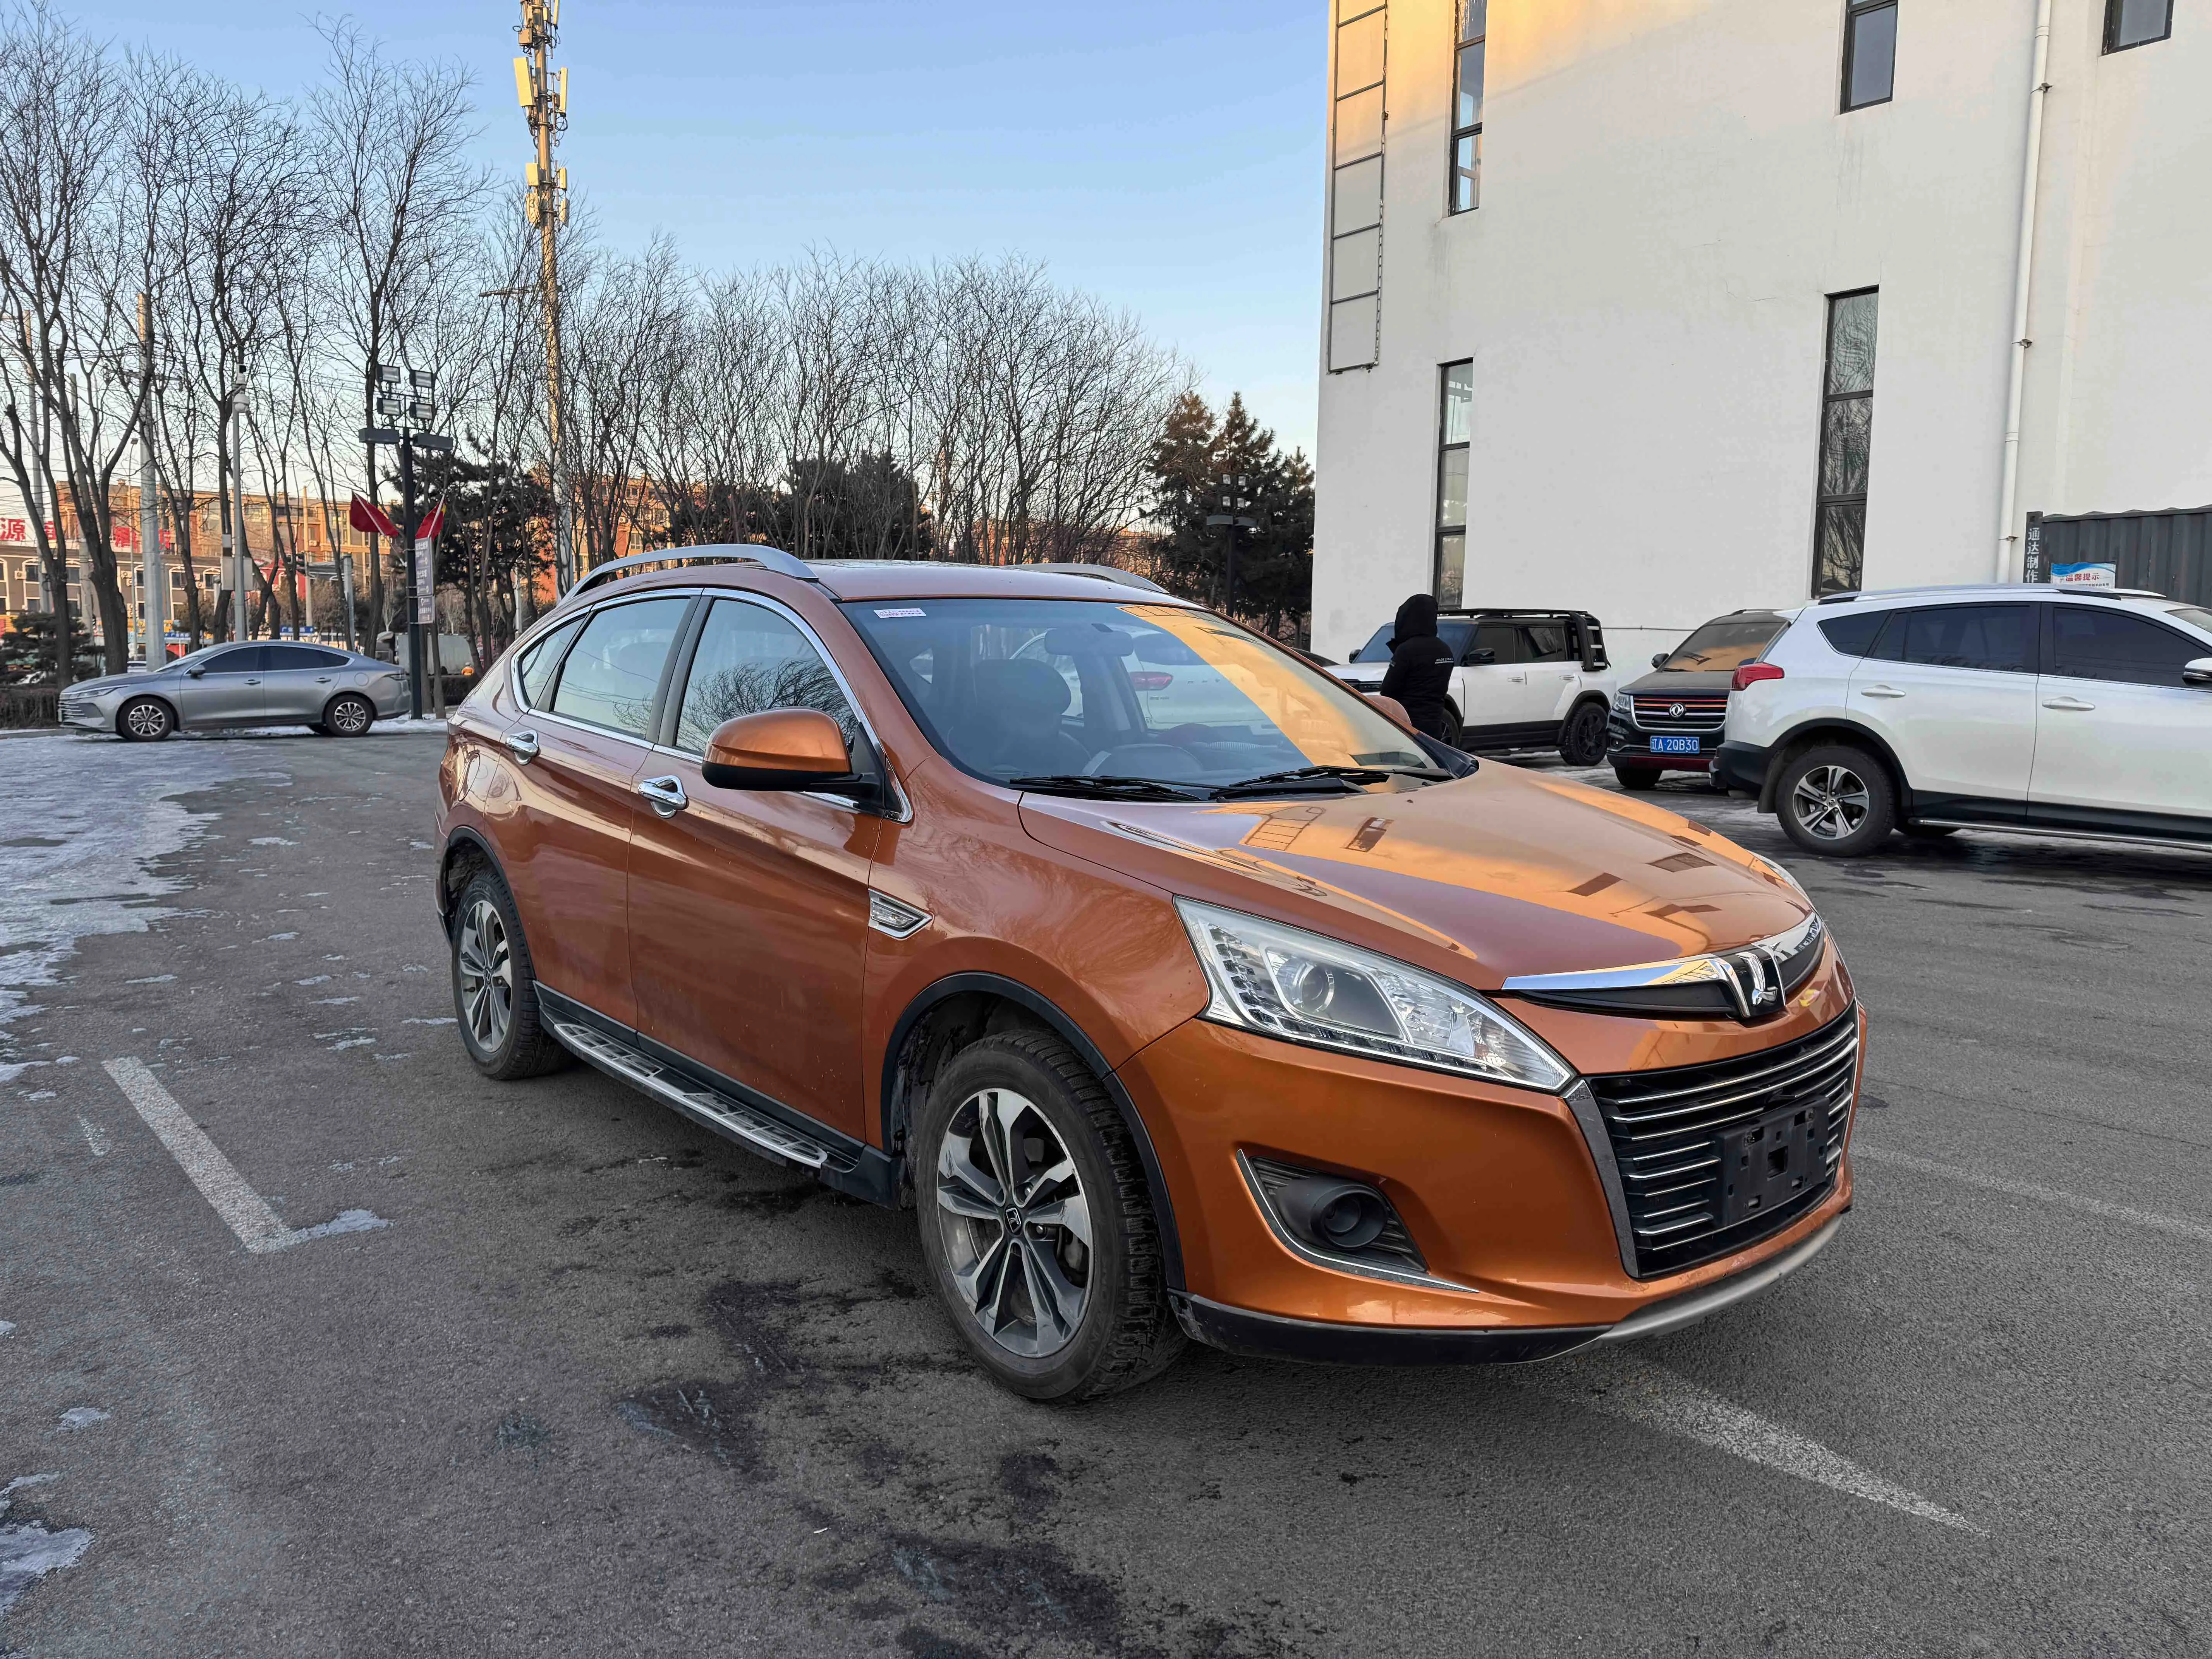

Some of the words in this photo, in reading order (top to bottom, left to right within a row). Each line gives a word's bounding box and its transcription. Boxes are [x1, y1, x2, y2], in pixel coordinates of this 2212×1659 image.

[2026, 527, 2040, 583] 通达制作
[2066, 573, 2100, 582] 温馨提示
